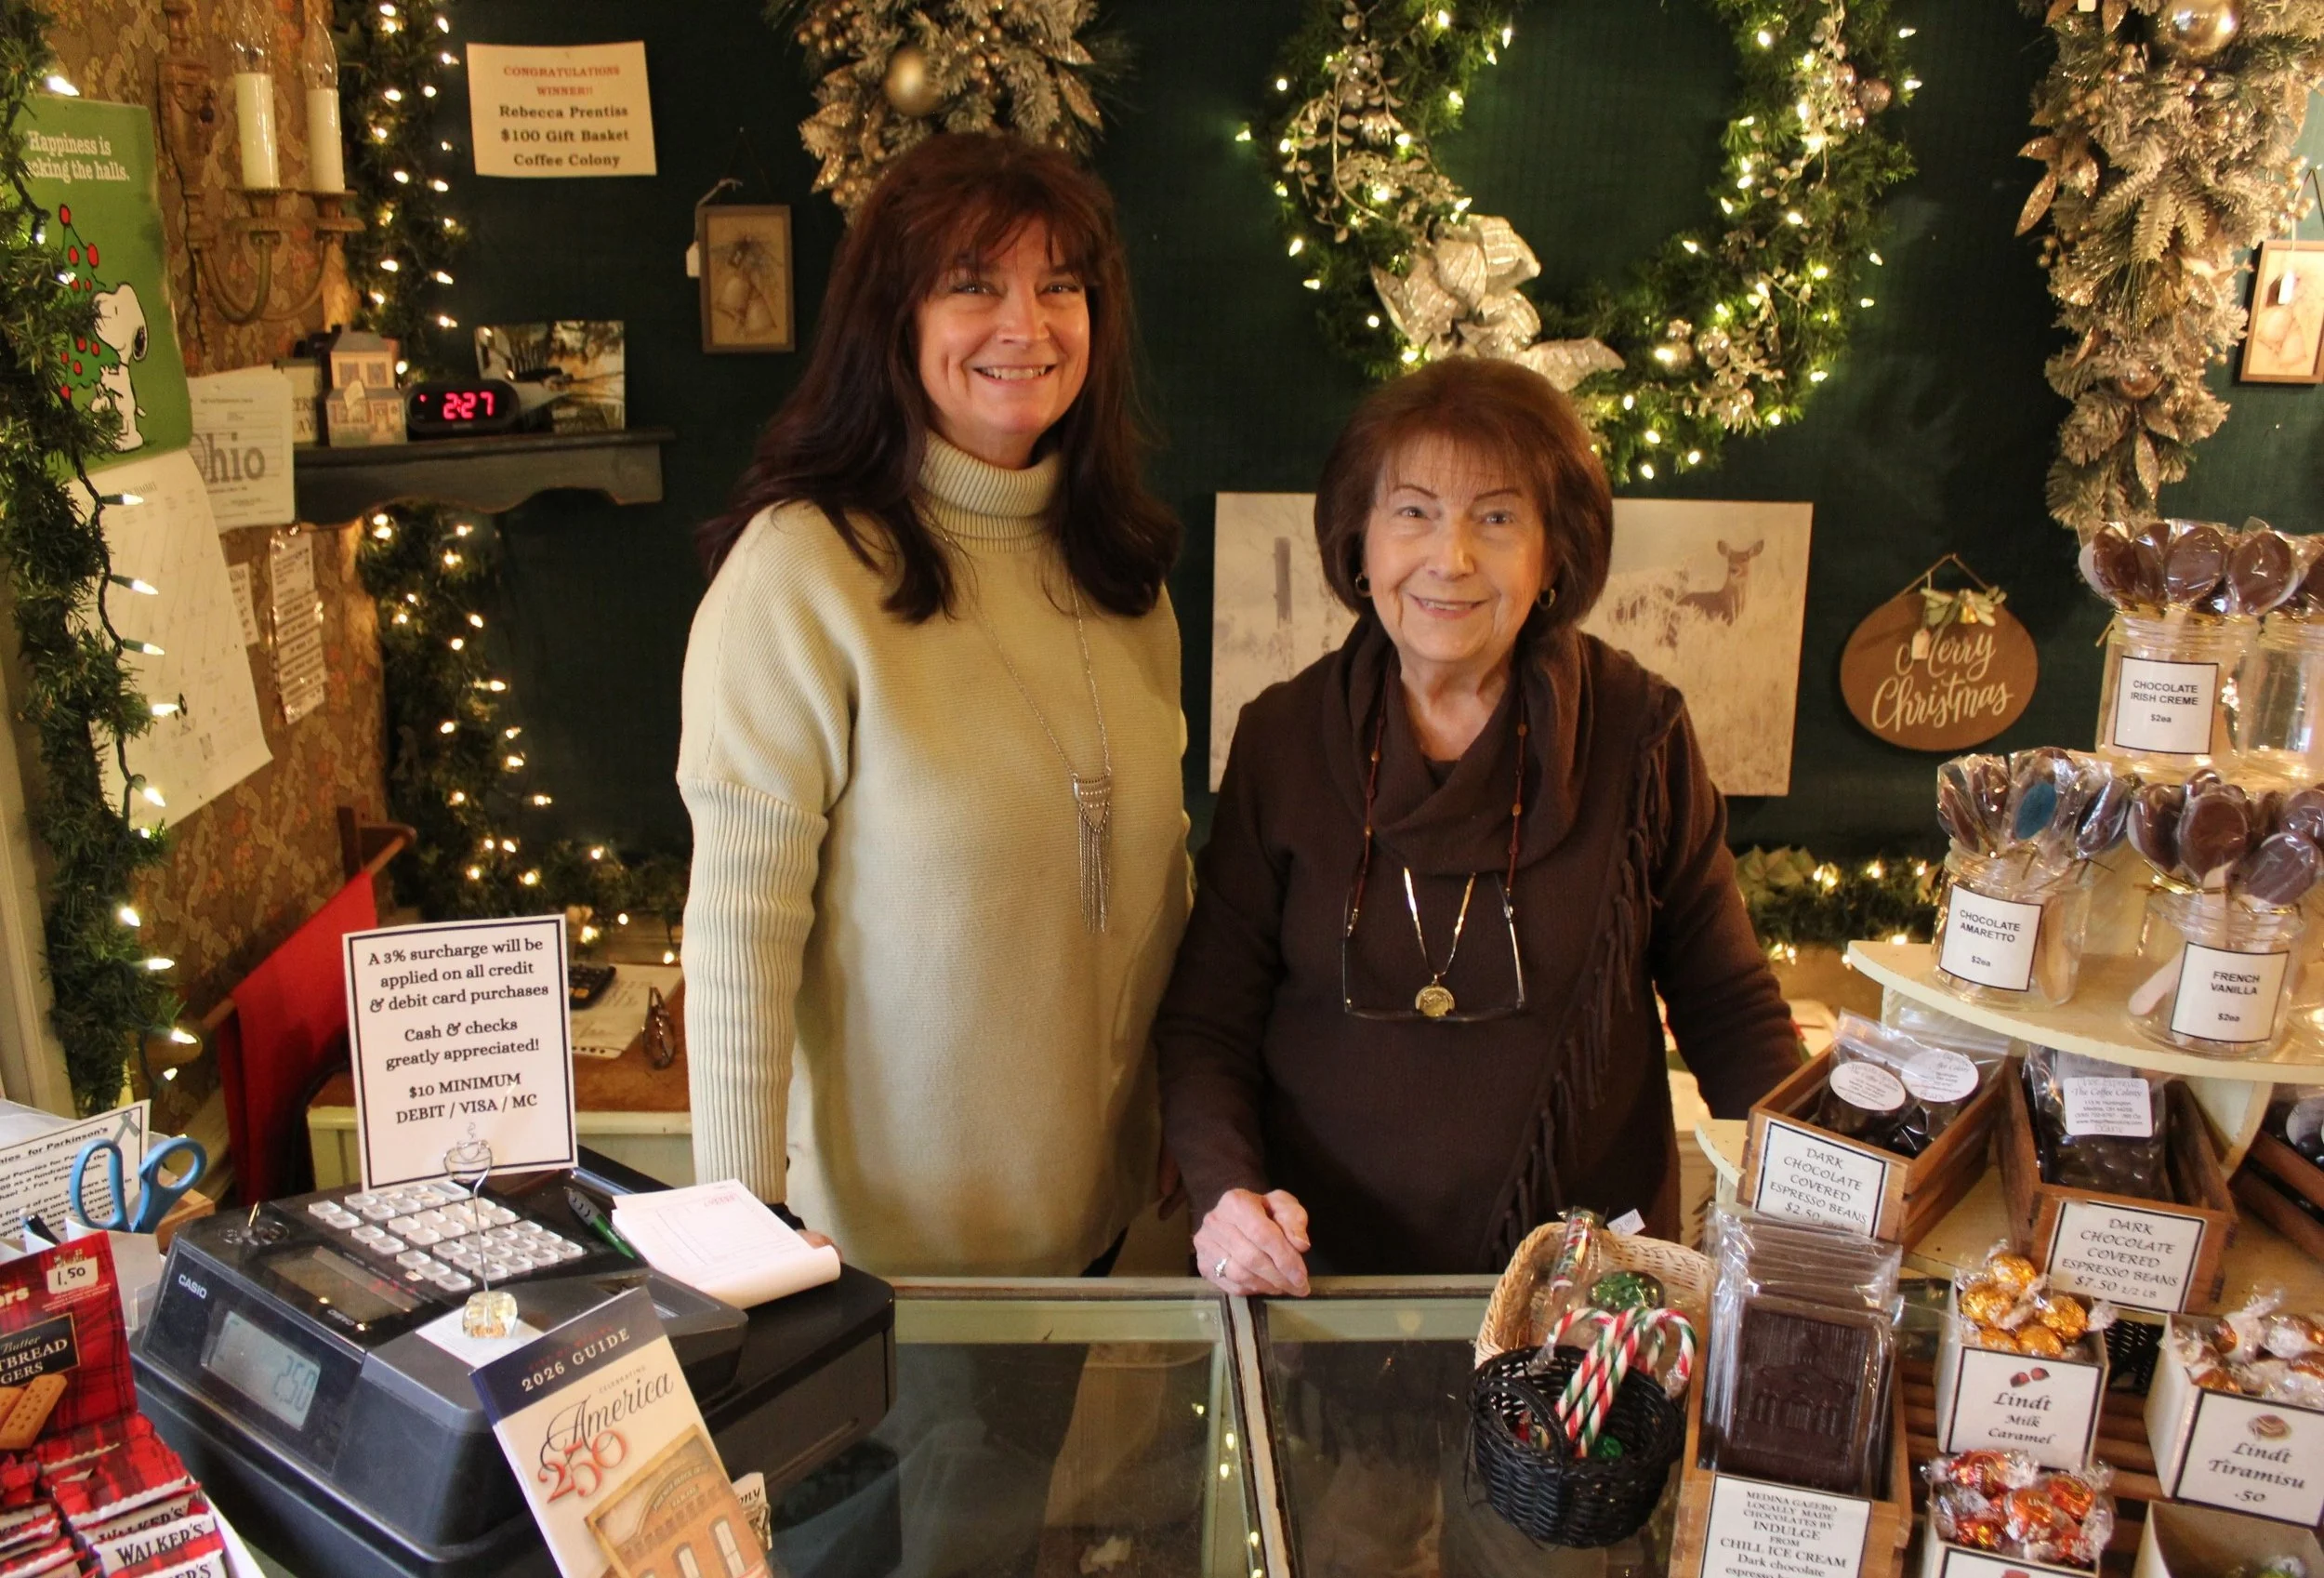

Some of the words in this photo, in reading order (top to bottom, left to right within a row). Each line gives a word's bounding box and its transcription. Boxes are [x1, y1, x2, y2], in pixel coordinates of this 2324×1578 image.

[504, 66, 621, 78] CONGRATULATIONS
[536, 86, 593, 97] WINNER!!
[499, 105, 563, 118] Rebecca
[570, 105, 628, 118] Prentiss
[27, 130, 99, 156] Happiness
[99, 136, 112, 156] is
[501, 128, 540, 143] $100
[547, 128, 575, 143] Gift
[581, 128, 629, 142] Basket
[72, 159, 94, 179] the
[93, 161, 130, 181] halls.
[514, 154, 563, 167] Coffee
[569, 153, 621, 168] Colony
[442, 391, 495, 420] 2:27
[1895, 626, 1997, 682] Merry
[2133, 680, 2199, 694] CHOCOLATE
[1872, 670, 2014, 733] Christmas
[2131, 692, 2157, 702] IRISH
[2159, 695, 2199, 706] CREME
[2150, 713, 2172, 723] $2ea
[1960, 909, 2021, 932] CHOCOLATE
[1961, 922, 2016, 943] AMARETTO
[367, 952, 381, 966] A
[384, 949, 406, 964] 3%
[410, 944, 489, 961] surcharge
[492, 938, 521, 954] will
[524, 938, 544, 951] be
[1971, 955, 1991, 967] $2ea
[380, 969, 439, 990] applied
[442, 970, 462, 981] on
[466, 965, 485, 978] all
[488, 961, 535, 977] credit
[2212, 970, 2261, 983] FRENCH
[369, 998, 385, 1014] &
[389, 994, 429, 1011] debit
[432, 989, 467, 1005] card
[470, 985, 549, 1005] purchases
[2211, 982, 2258, 995] VANILLA
[404, 1026, 442, 1042] Cash
[446, 1022, 462, 1037] &
[465, 1018, 519, 1035] checks
[386, 1049, 441, 1071] greatly
[443, 1038, 540, 1062] appreciated!
[409, 1084, 435, 1099] $10
[439, 1073, 522, 1094] MINIMUM
[396, 1104, 445, 1124] DEBIT
[449, 1102, 456, 1119] /
[459, 1099, 498, 1114] VISA
[502, 1096, 508, 1113] /
[511, 1094, 538, 1109] MC
[28, 1145, 43, 1156] for
[46, 1126, 109, 1151] Parkinson's
[1806, 1147, 1845, 1170] DARK
[34, 1164, 73, 1179] fundraise
[1784, 1156, 1863, 1191] CHOCOLATE
[1790, 1174, 1851, 1202] COVERED
[1770, 1181, 1826, 1208] ESPRESSO
[1829, 1203, 1868, 1225] BEANS
[1785, 1201, 1820, 1222] $2.50
[2109, 1218, 2155, 1236] DARK
[2080, 1230, 2176, 1254] CHOCOLATE
[2087, 1247, 2161, 1268] COVERED
[58, 1266, 86, 1286] 1.50
[2062, 1258, 2129, 1279] ESPRESSO
[2133, 1271, 2179, 1287] BEANS
[178, 1274, 207, 1299] CASIO
[2075, 1276, 2118, 1293] $7.50
[0, 1339, 68, 1372] TBREAD
[522, 1361, 566, 1392] 2026
[572, 1328, 630, 1366] GUIDE
[0, 1361, 44, 1385] GERS
[1993, 1392, 2052, 1412] Lindt
[540, 1372, 674, 1472] America
[2004, 1414, 2041, 1428] Milk
[1988, 1427, 2057, 1444] Caramel
[2233, 1441, 2292, 1464] Lindt
[537, 1429, 627, 1504] 250
[2209, 1459, 2305, 1489] Tiramisu
[1747, 1491, 1789, 1505] MEDINA
[1792, 1499, 1838, 1512] GAZEBO
[2235, 1490, 2266, 1502] .50
[1743, 1509, 1816, 1527] CHOCOLATES
[1819, 1521, 1834, 1531] BY
[1747, 1501, 1797, 1515] LOCALLY
[1802, 1509, 1834, 1520] MADE
[1753, 1520, 1821, 1541] INDULGE
[1770, 1535, 1801, 1547] FROM
[116, 1523, 204, 1566] WALKER'S
[1720, 1537, 1764, 1554] CHILL
[1769, 1545, 1792, 1558] ICE
[1795, 1550, 1847, 1569] CREAM
[1725, 1567, 1776, 1578] espresso
[1737, 1554, 1766, 1568] Dark
[1770, 1559, 1825, 1577] chocolate
